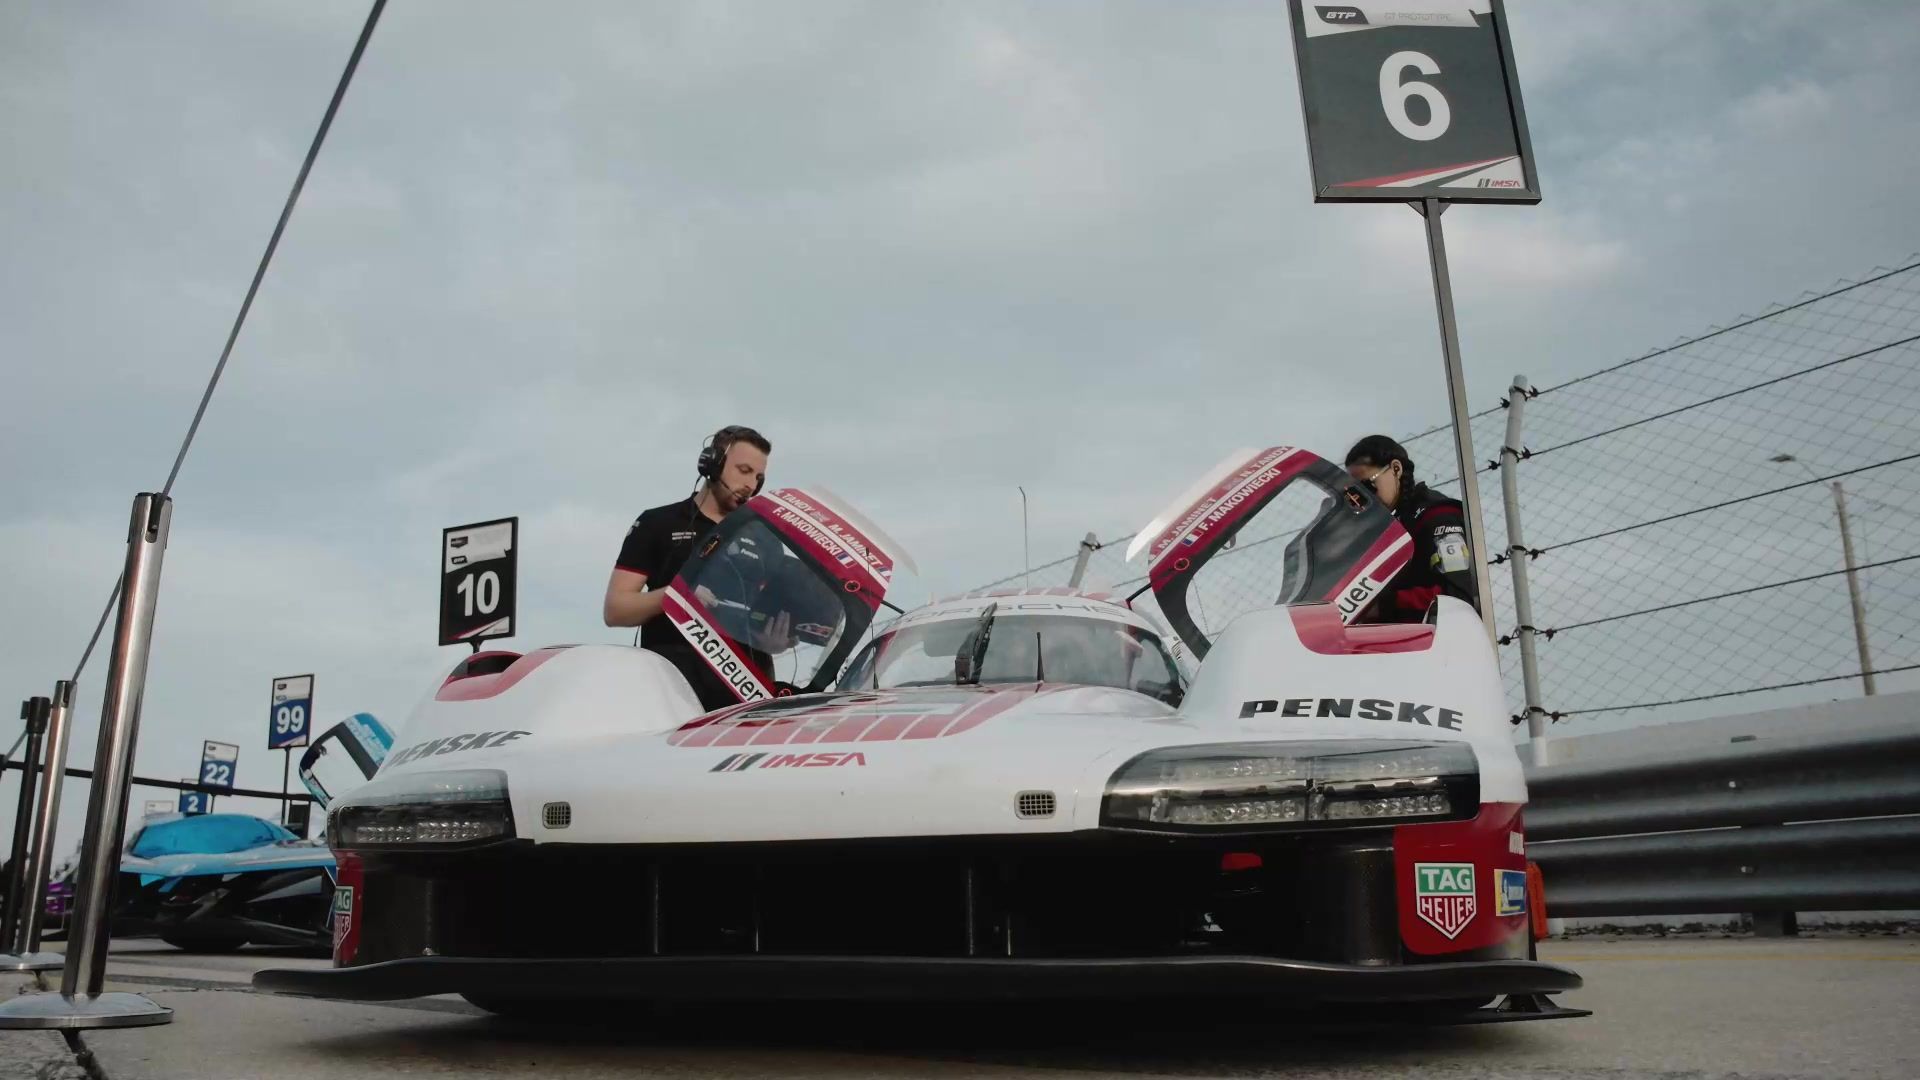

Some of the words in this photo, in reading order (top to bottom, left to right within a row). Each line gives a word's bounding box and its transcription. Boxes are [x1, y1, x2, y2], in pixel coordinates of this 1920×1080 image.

[1325, 11, 1357, 19] GTP
[1379, 50, 1451, 142] 6
[1490, 179, 1521, 188] IMSA
[1171, 497, 1217, 537] JAMINET
[1253, 445, 1290, 470] TANDY
[1199, 521, 1215, 532] F.
[1208, 467, 1282, 524] MAKOWIECKI
[780, 511, 842, 556] MAKOWIECKI
[1446, 544, 1455, 555] 6
[457, 570, 500, 617] 10
[276, 704, 305, 735] 99
[1239, 699, 1464, 731] PENSKE
[384, 729, 534, 769] PENSKE
[758, 751, 867, 769] IMSA
[204, 763, 230, 785] 22
[187, 795, 198, 812] 2
[1420, 868, 1472, 890] TAG
[1421, 897, 1474, 933] HEUER
